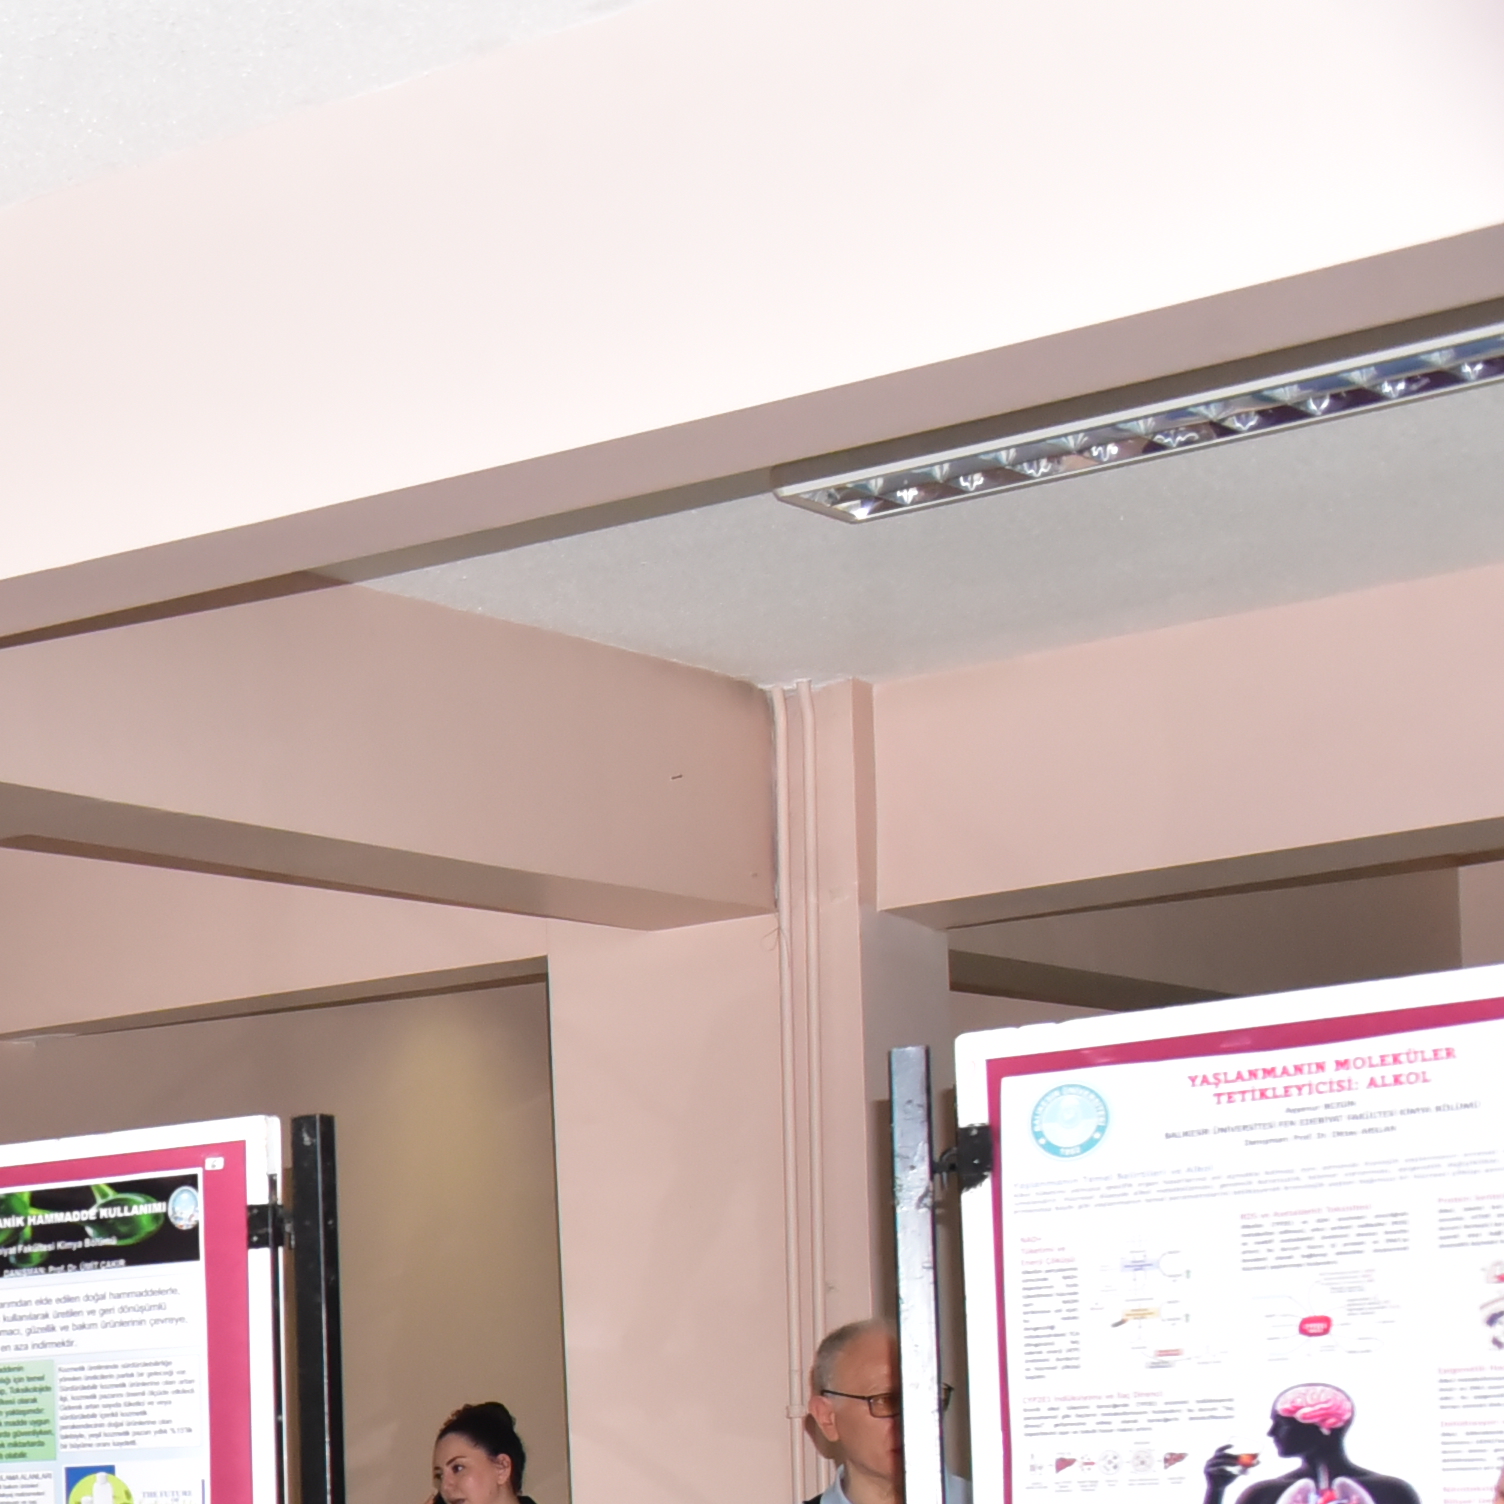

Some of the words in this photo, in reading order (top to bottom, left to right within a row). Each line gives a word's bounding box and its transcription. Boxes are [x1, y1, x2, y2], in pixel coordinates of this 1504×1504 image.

[1187, 1061, 1326, 1088] YAŞLANMANIN
[1334, 1047, 1457, 1072] MOLEKÜLER
[1366, 1071, 1432, 1089] ALKOL
[27, 1209, 97, 1226] HAMMADDE
